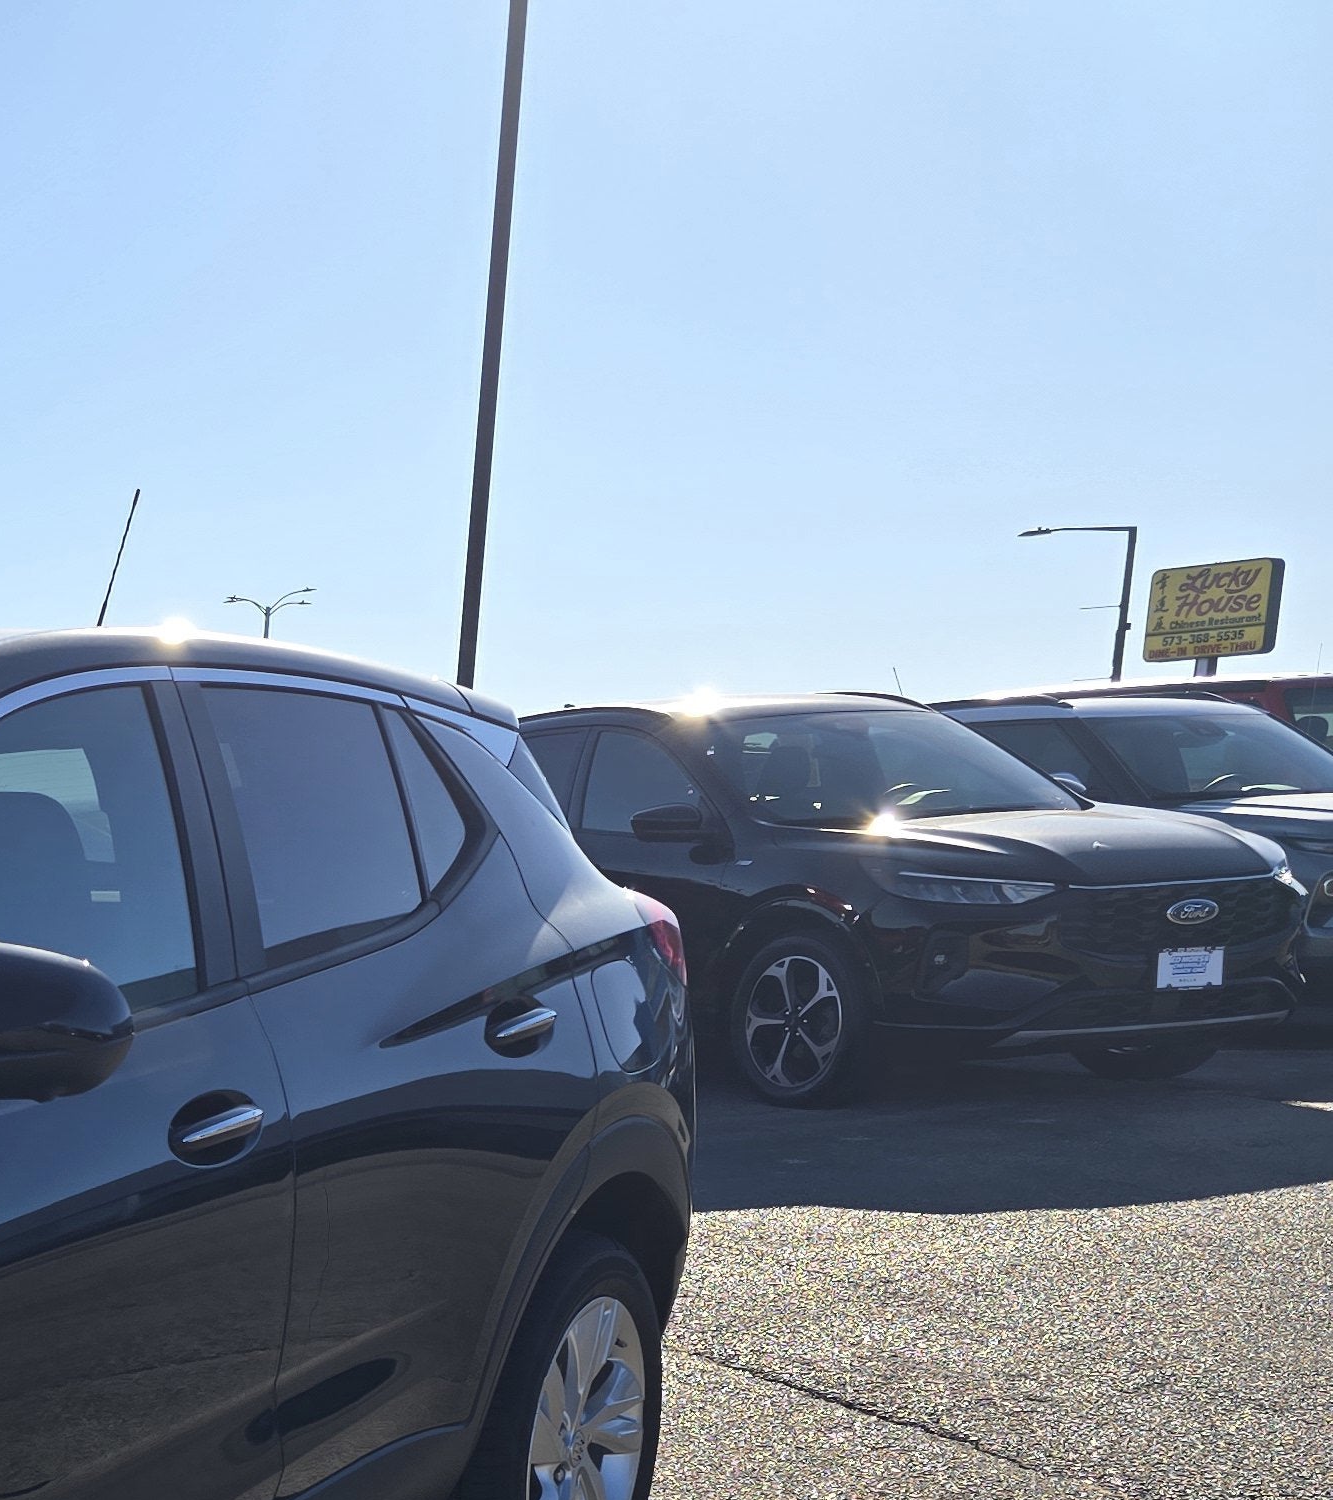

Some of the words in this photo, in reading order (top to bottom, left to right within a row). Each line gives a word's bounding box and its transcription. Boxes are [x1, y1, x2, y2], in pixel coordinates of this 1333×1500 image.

[1179, 566, 1262, 594] Lucky
[1175, 593, 1262, 619] House
[1169, 618, 1206, 630] Chinese
[1208, 613, 1261, 626] Restaurant
[1148, 646, 1187, 659] DINE-IN
[1193, 640, 1257, 655] DRIVE-THRU
[1180, 904, 1210, 919] Ford
